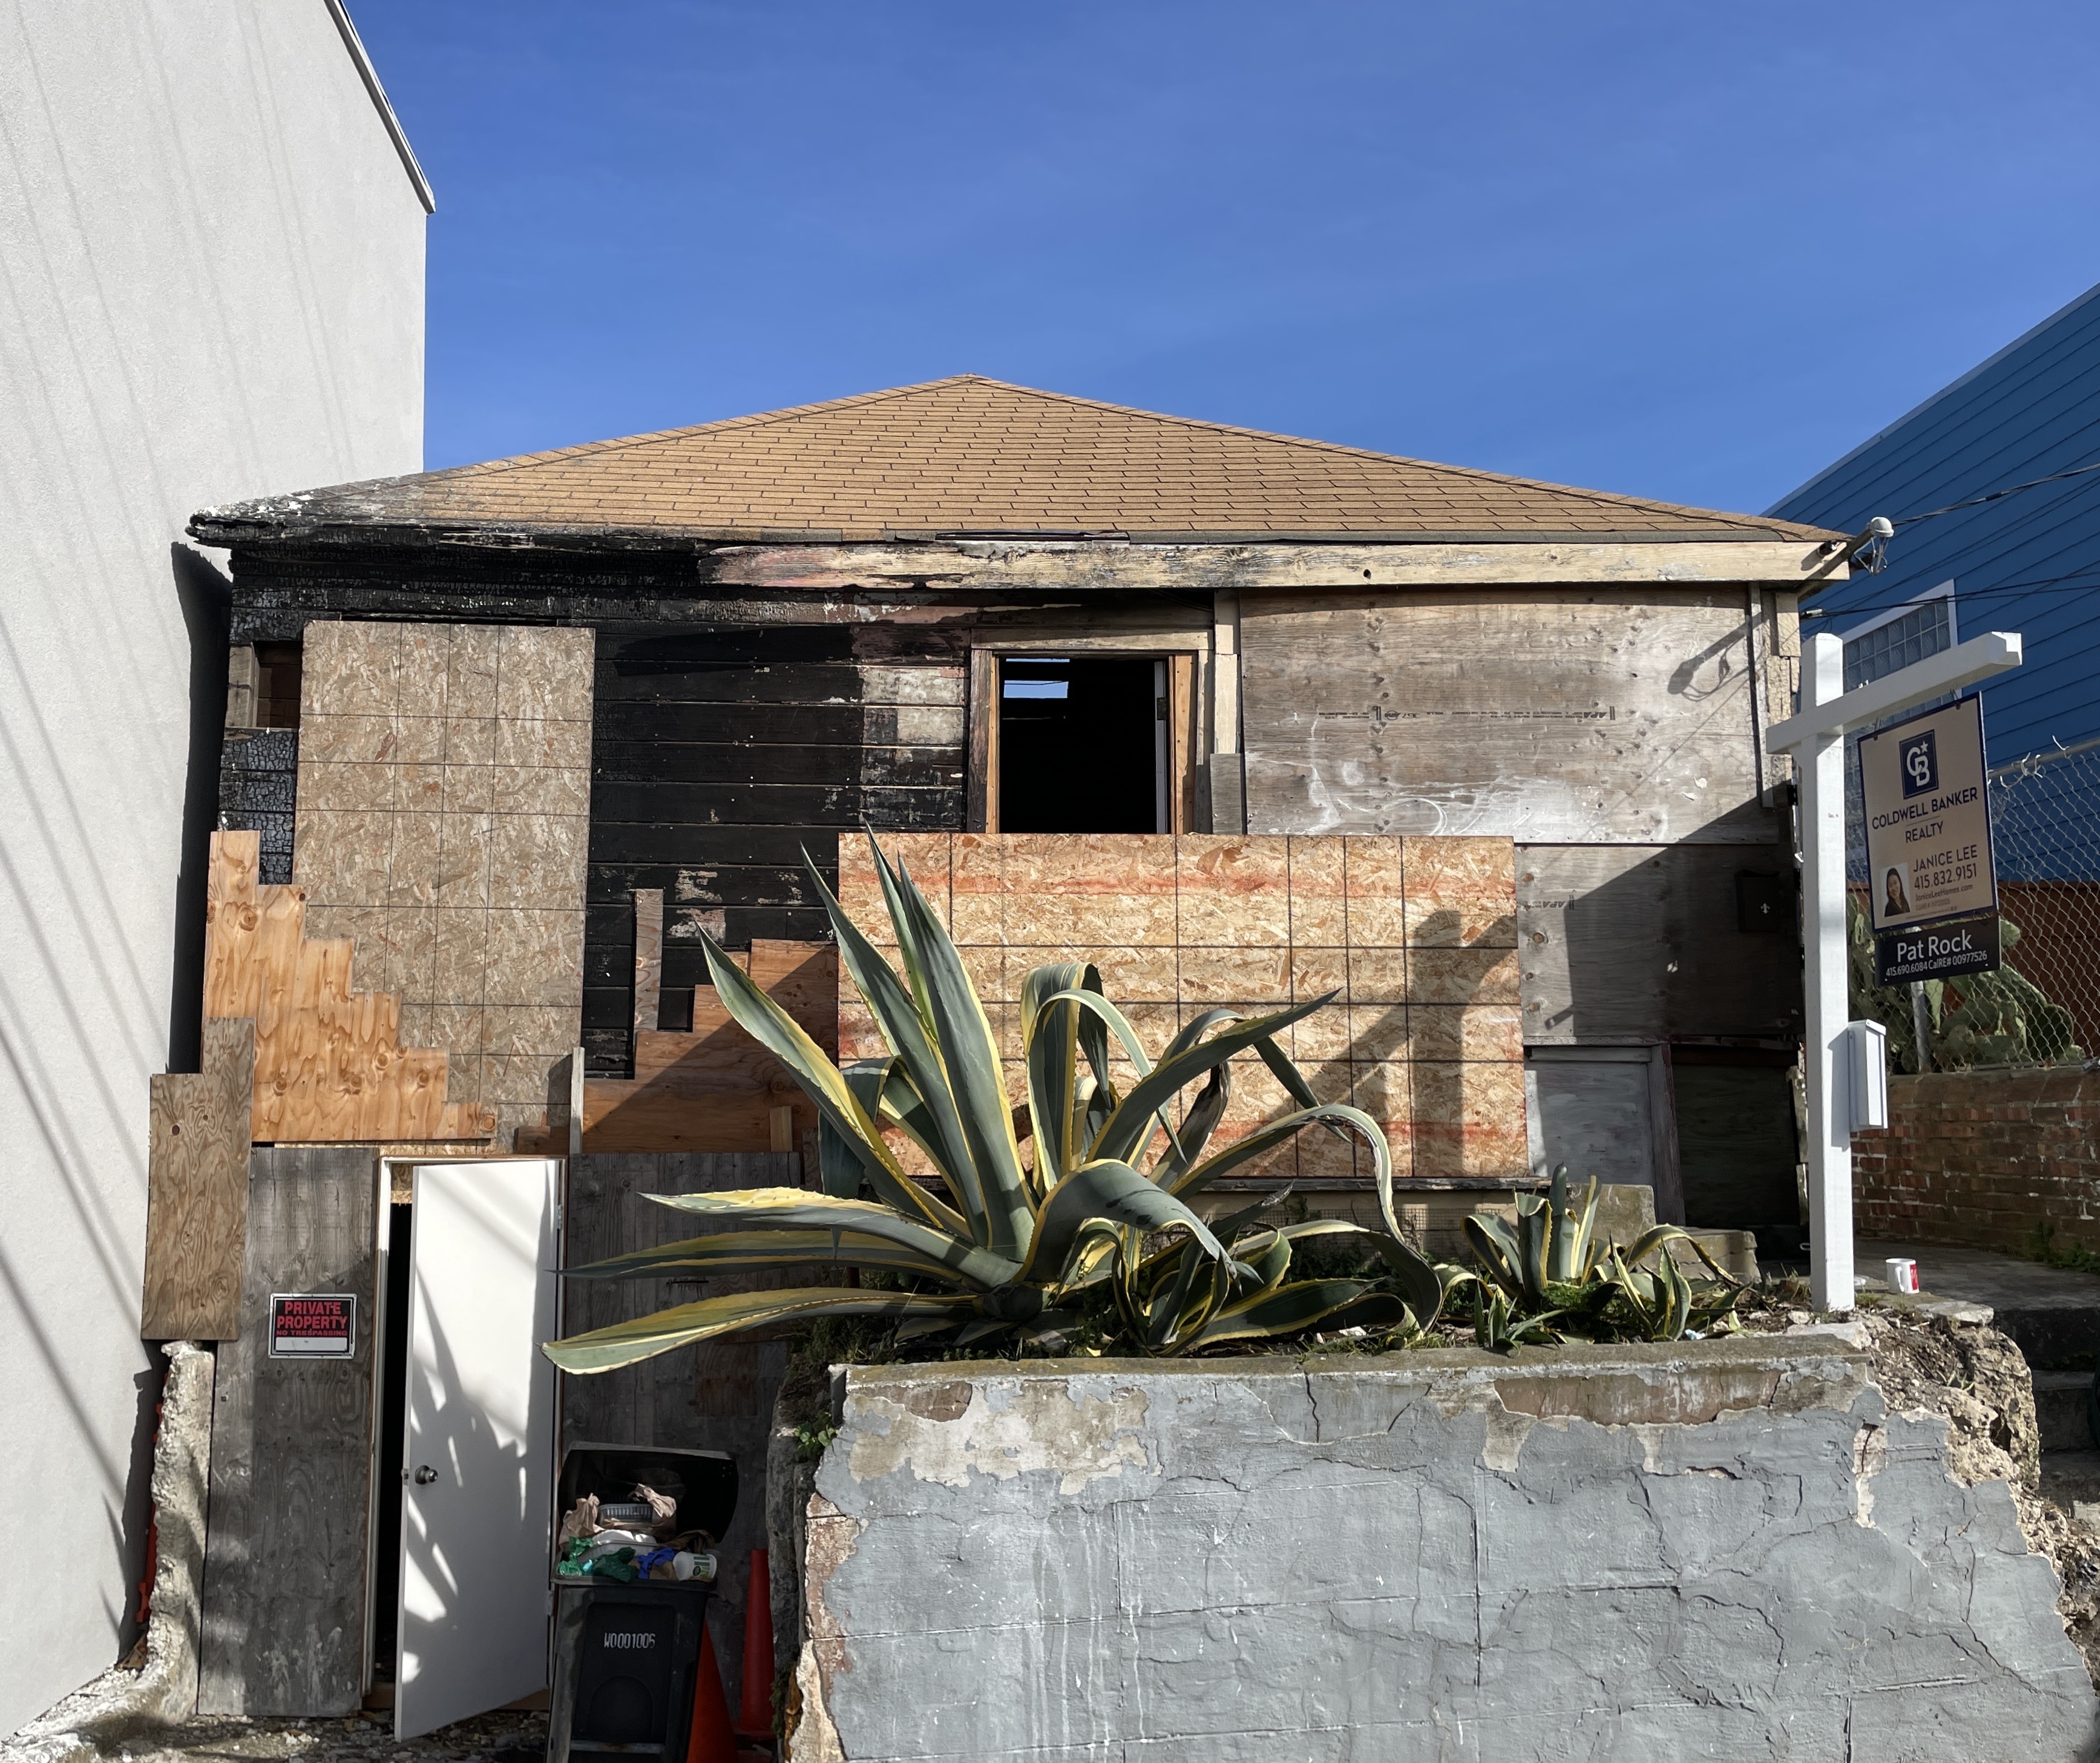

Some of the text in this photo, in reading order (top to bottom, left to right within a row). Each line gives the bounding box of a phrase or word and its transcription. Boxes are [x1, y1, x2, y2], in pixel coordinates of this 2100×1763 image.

[1872, 787, 1978, 830] COLDWELL BANKER
[1906, 821, 1944, 844] REALTY
[1913, 844, 1978, 873] JANICE LEE
[1914, 862, 1977, 890] 415.832.9151
[1897, 929, 1972, 962] Pat Rock
[1886, 950, 1987, 977] 415.690.6084 CalRE# 00977526
[284, 1301, 341, 1315] PRIVATE
[277, 1316, 348, 1329] PROPERTY
